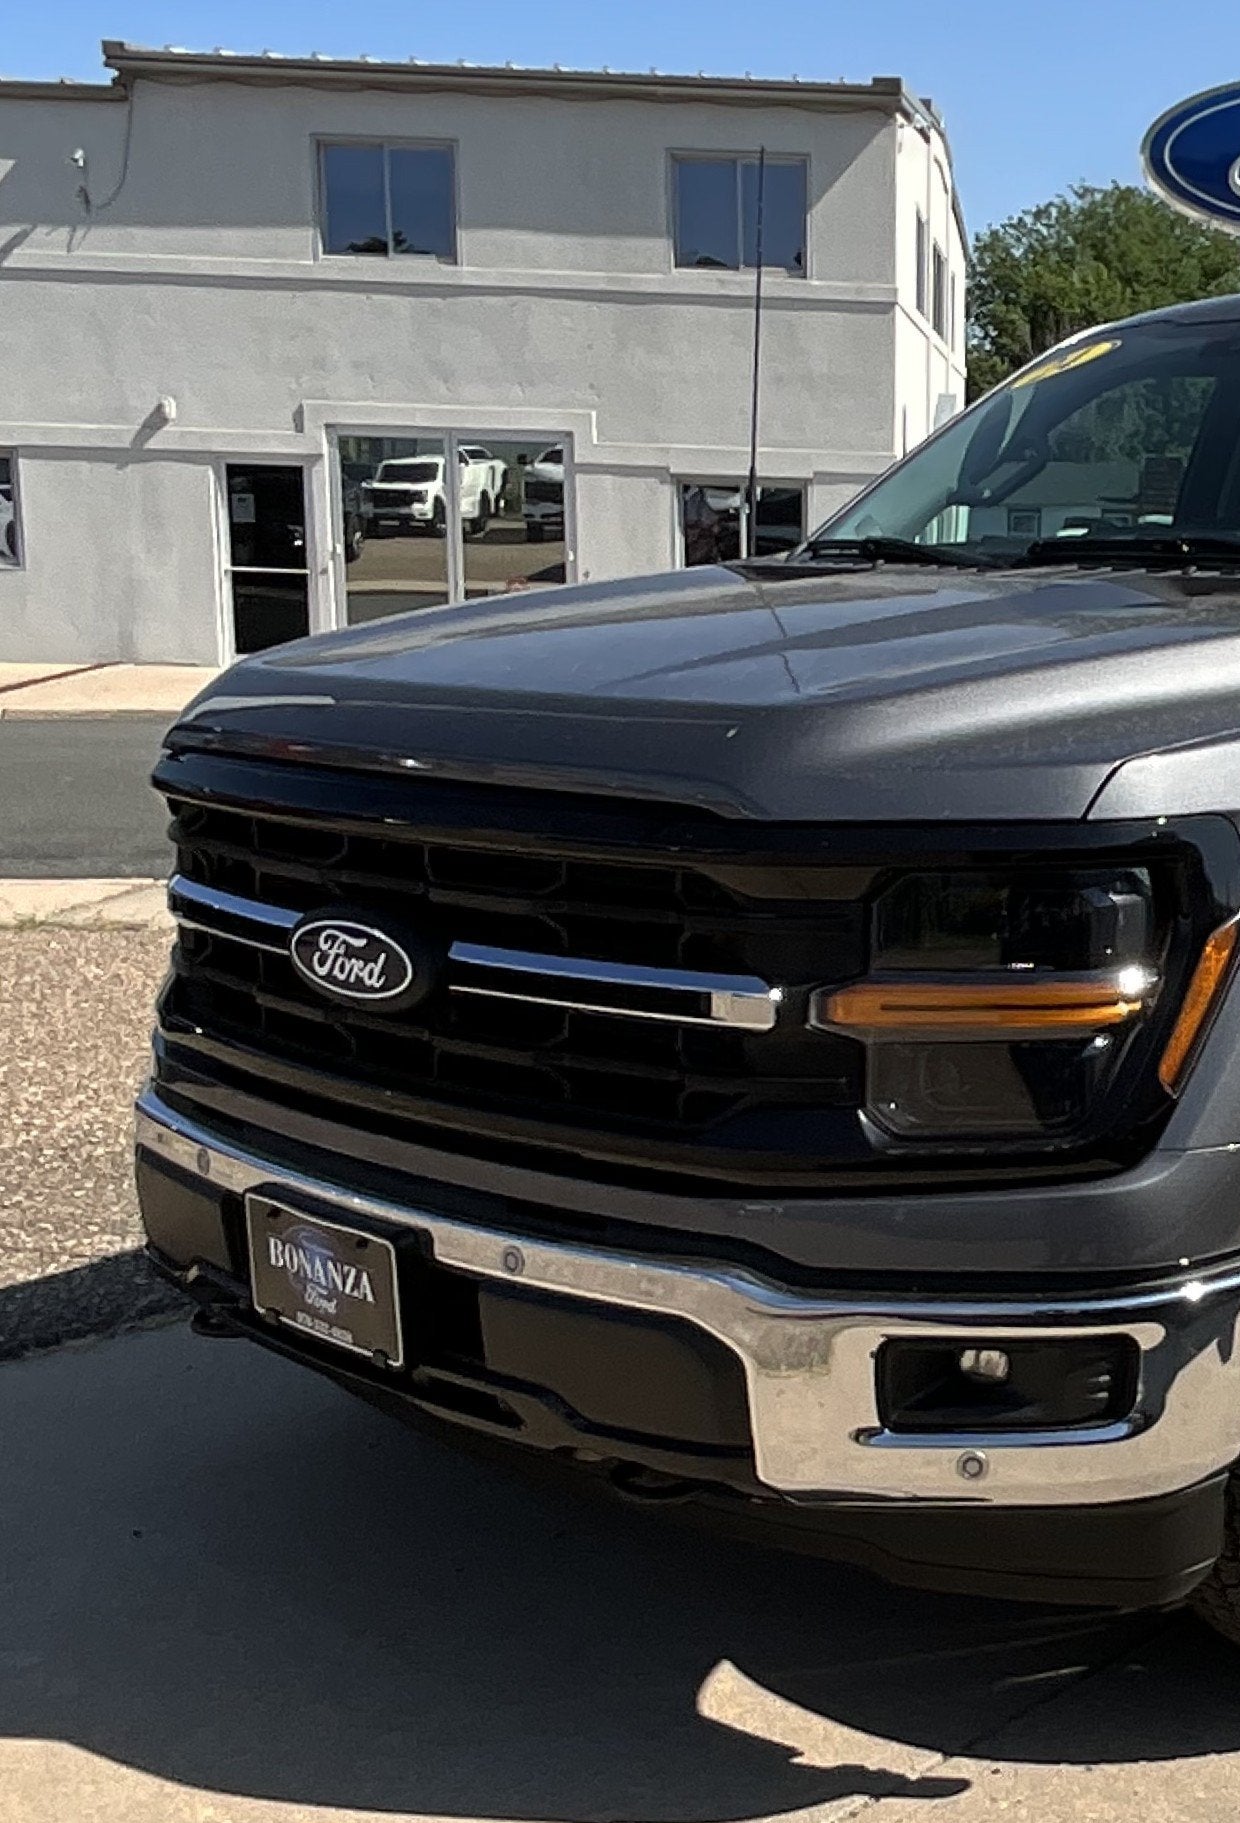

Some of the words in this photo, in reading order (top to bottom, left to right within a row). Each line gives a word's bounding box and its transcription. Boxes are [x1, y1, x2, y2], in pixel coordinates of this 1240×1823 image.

[313, 929, 386, 988] Ford
[268, 1234, 376, 1304] BONANZA
[304, 1283, 338, 1314] Ford
